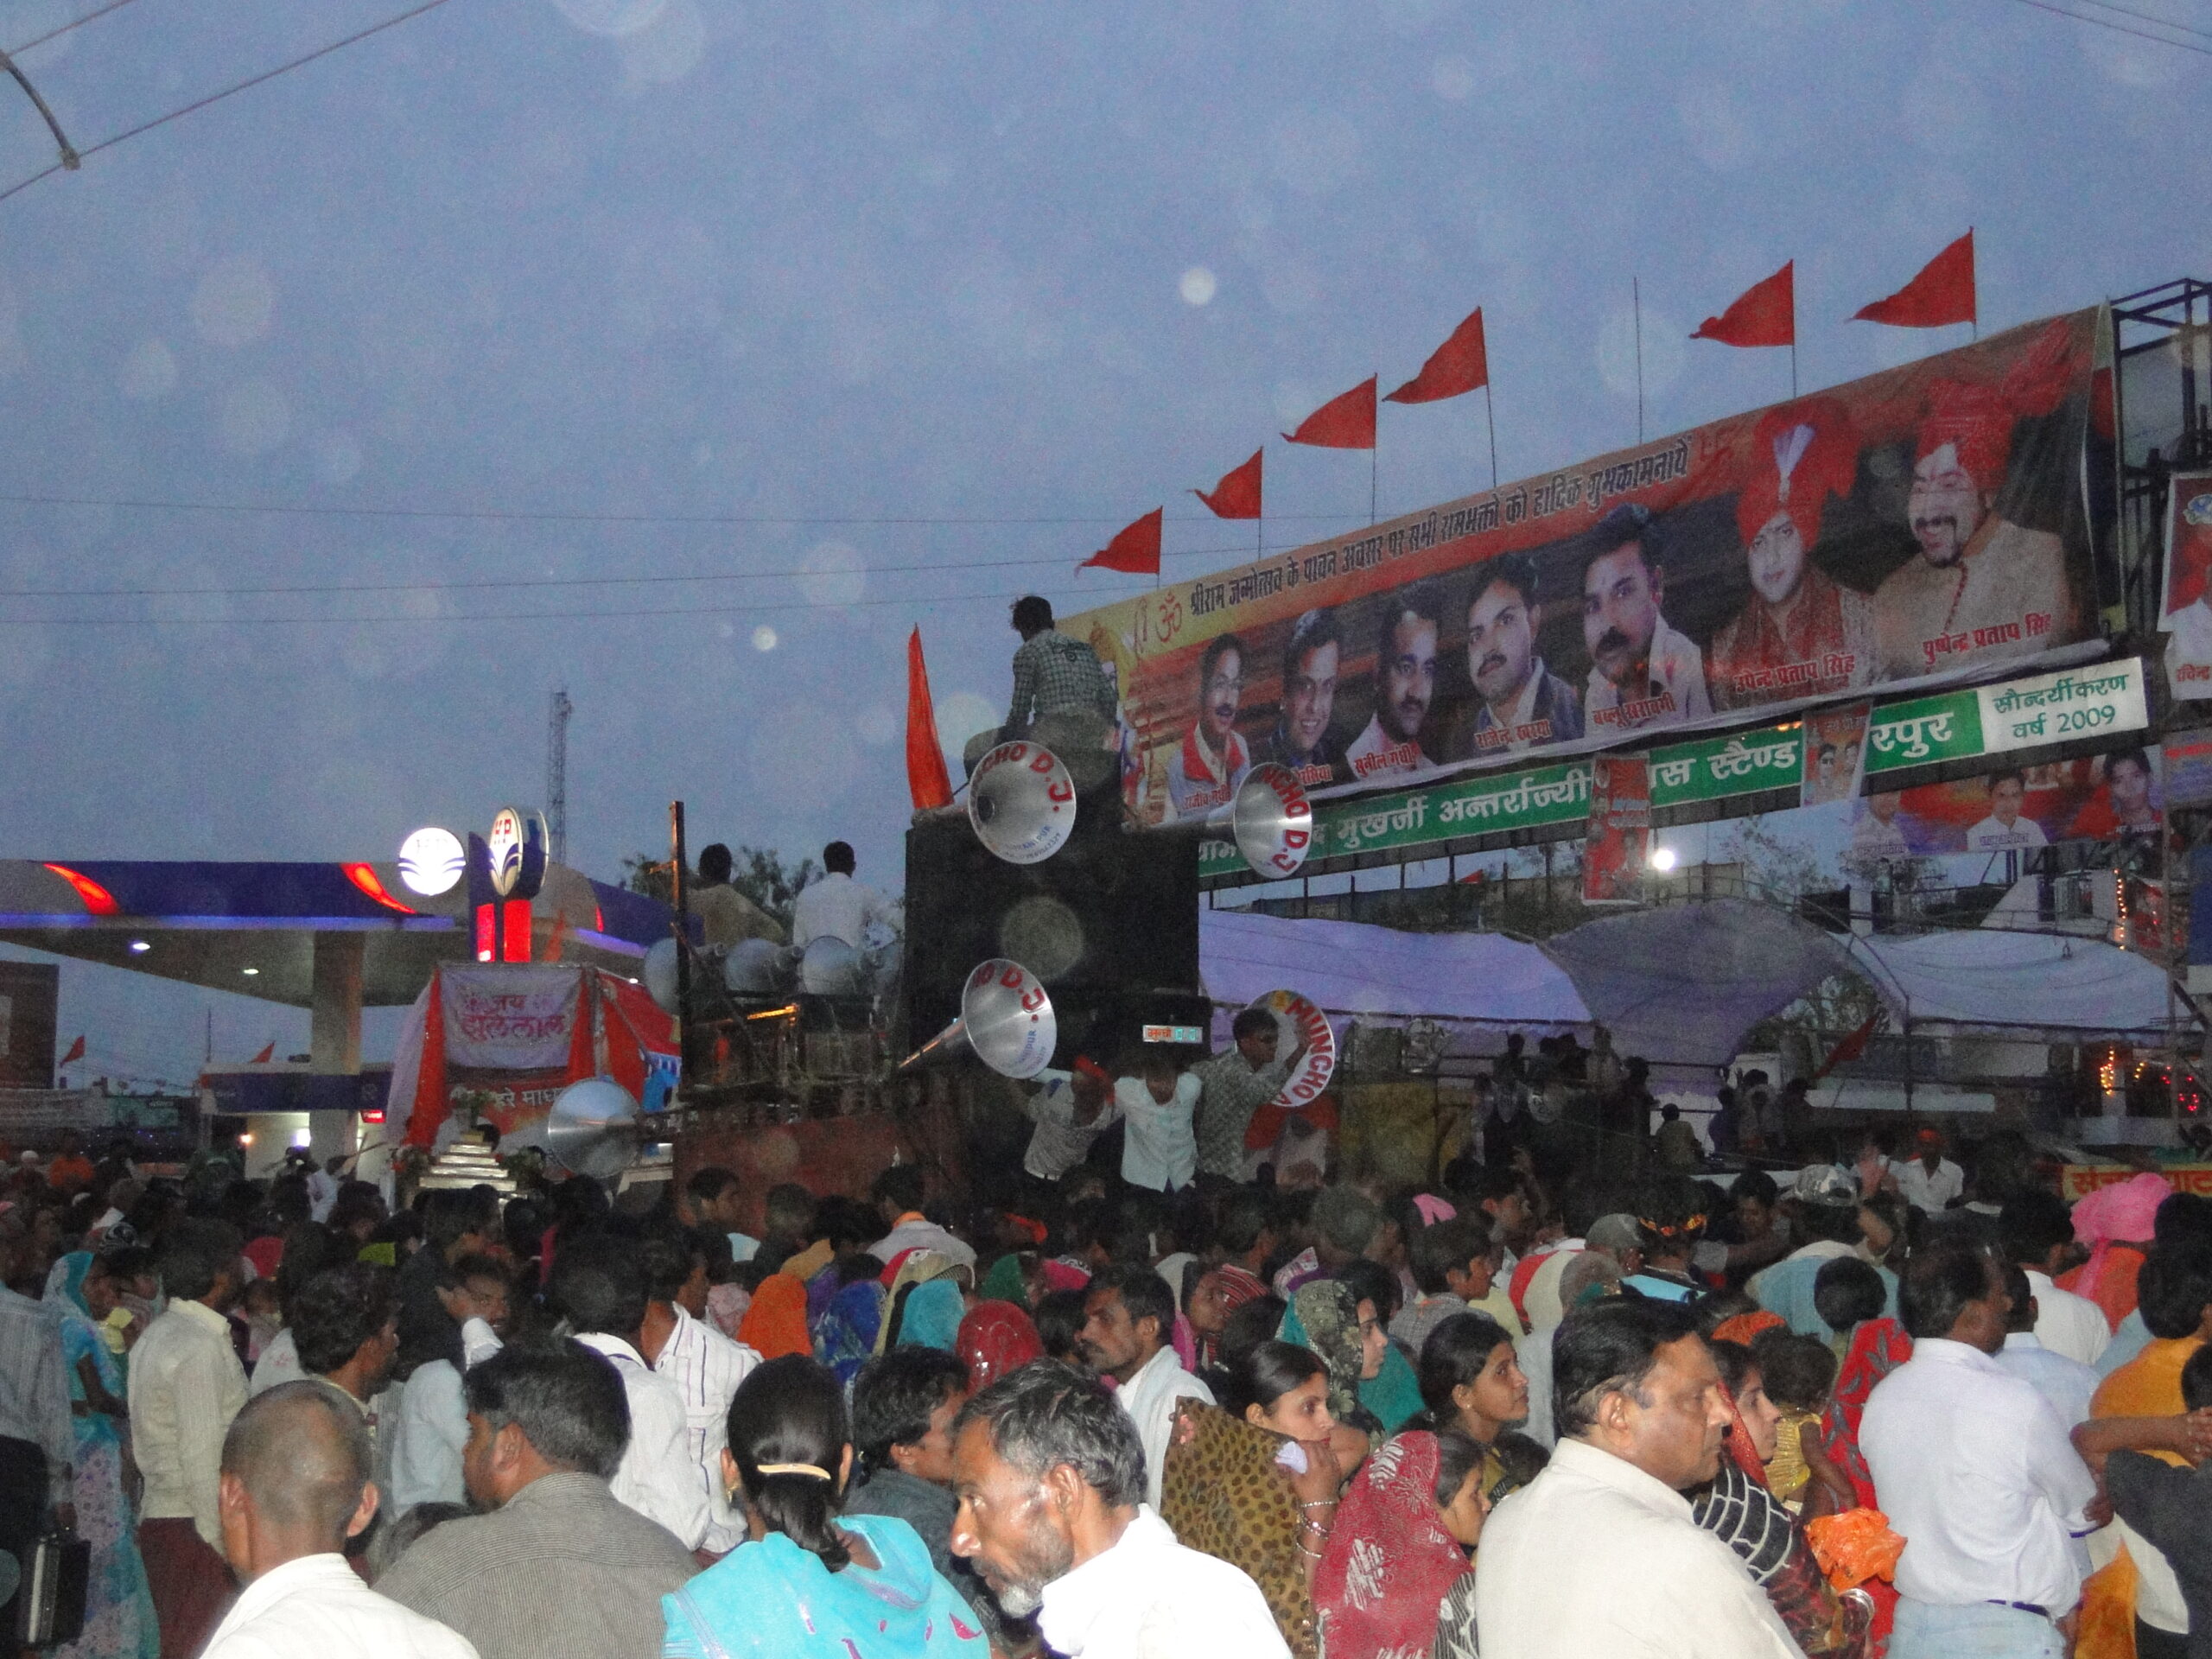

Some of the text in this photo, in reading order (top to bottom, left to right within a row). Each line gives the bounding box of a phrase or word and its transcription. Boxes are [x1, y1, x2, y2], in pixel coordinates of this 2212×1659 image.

[1287, 556, 1299, 588] के
[1303, 550, 1338, 583] पावन
[1342, 536, 1383, 573] अवसर
[1388, 529, 1405, 557] पर
[1409, 511, 1439, 554] सभी
[1506, 485, 1529, 524] को
[1972, 620, 2021, 649] प्रताप
[1775, 660, 1819, 687] प्रताप
[2012, 704, 2116, 740] वर्ष 2009
[1338, 795, 1429, 849] मुखर्जी
[1439, 768, 1592, 823] अन्तर्राज्यी
